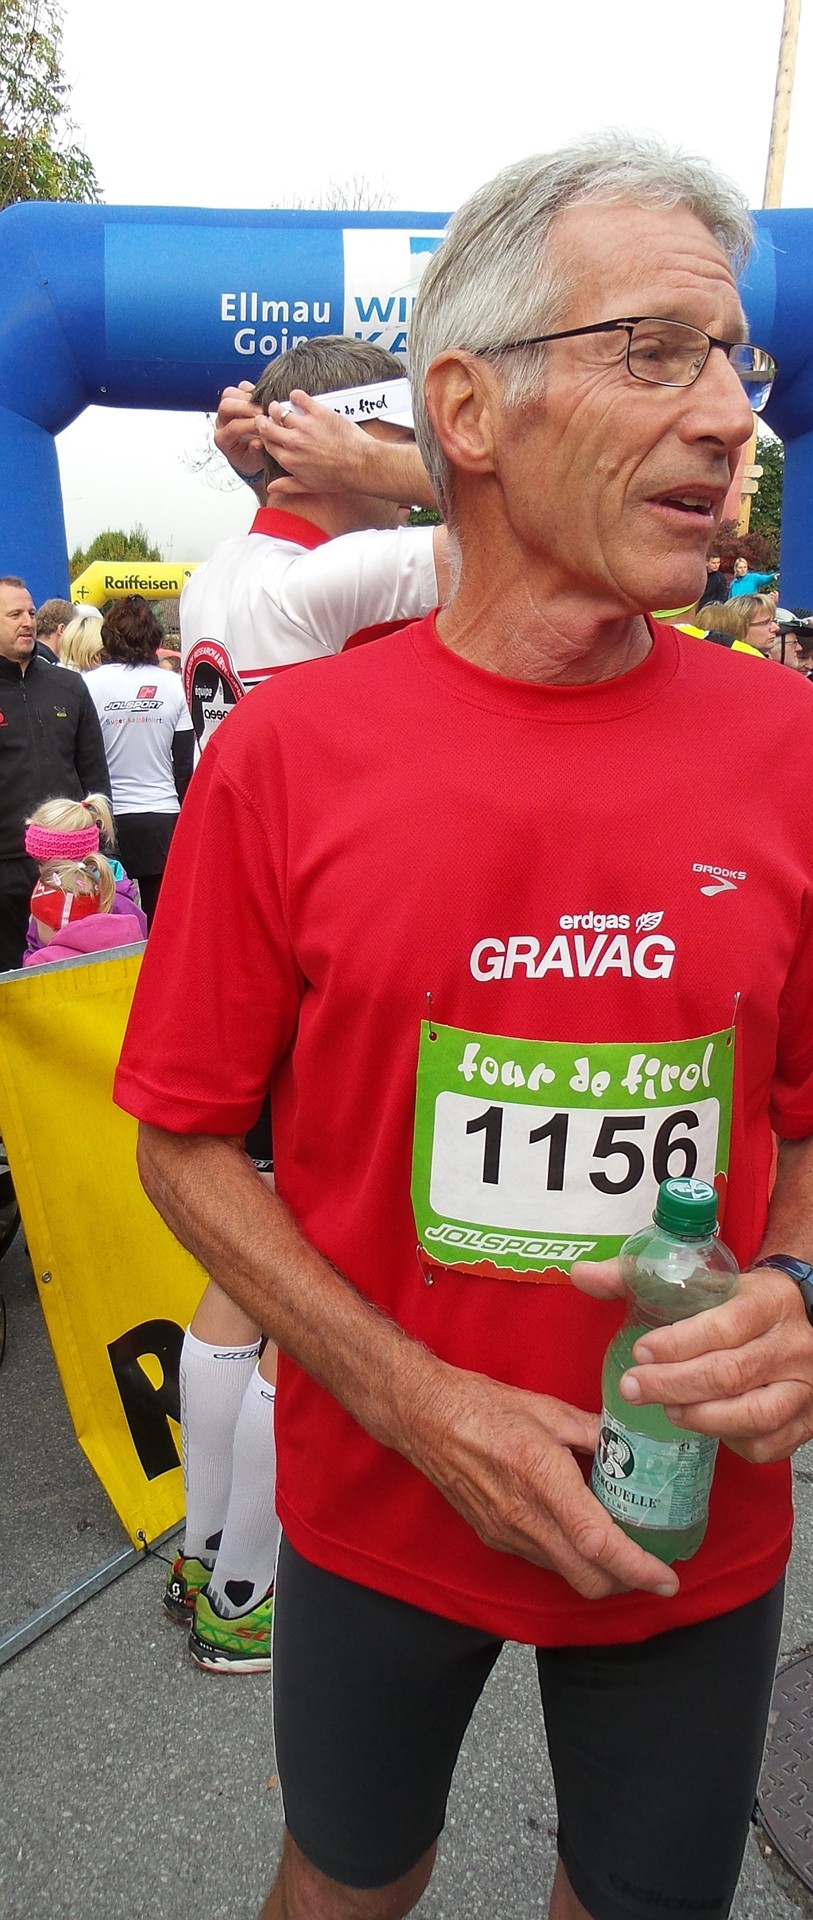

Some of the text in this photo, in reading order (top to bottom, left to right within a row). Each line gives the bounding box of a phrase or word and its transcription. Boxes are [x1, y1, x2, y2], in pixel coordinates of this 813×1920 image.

[220, 291, 331, 324] Ellmau
[104, 575, 179, 591] Raiffeisen
[103, 700, 164, 711] JOLSPORT
[692, 863, 747, 880] BROOKS
[559, 911, 630, 932] erdgas
[469, 934, 676, 982] GRAVAG
[457, 1042, 714, 1100] tour de tirol
[465, 1105, 700, 1195] 1156
[424, 1223, 598, 1260] JOLSPORT
